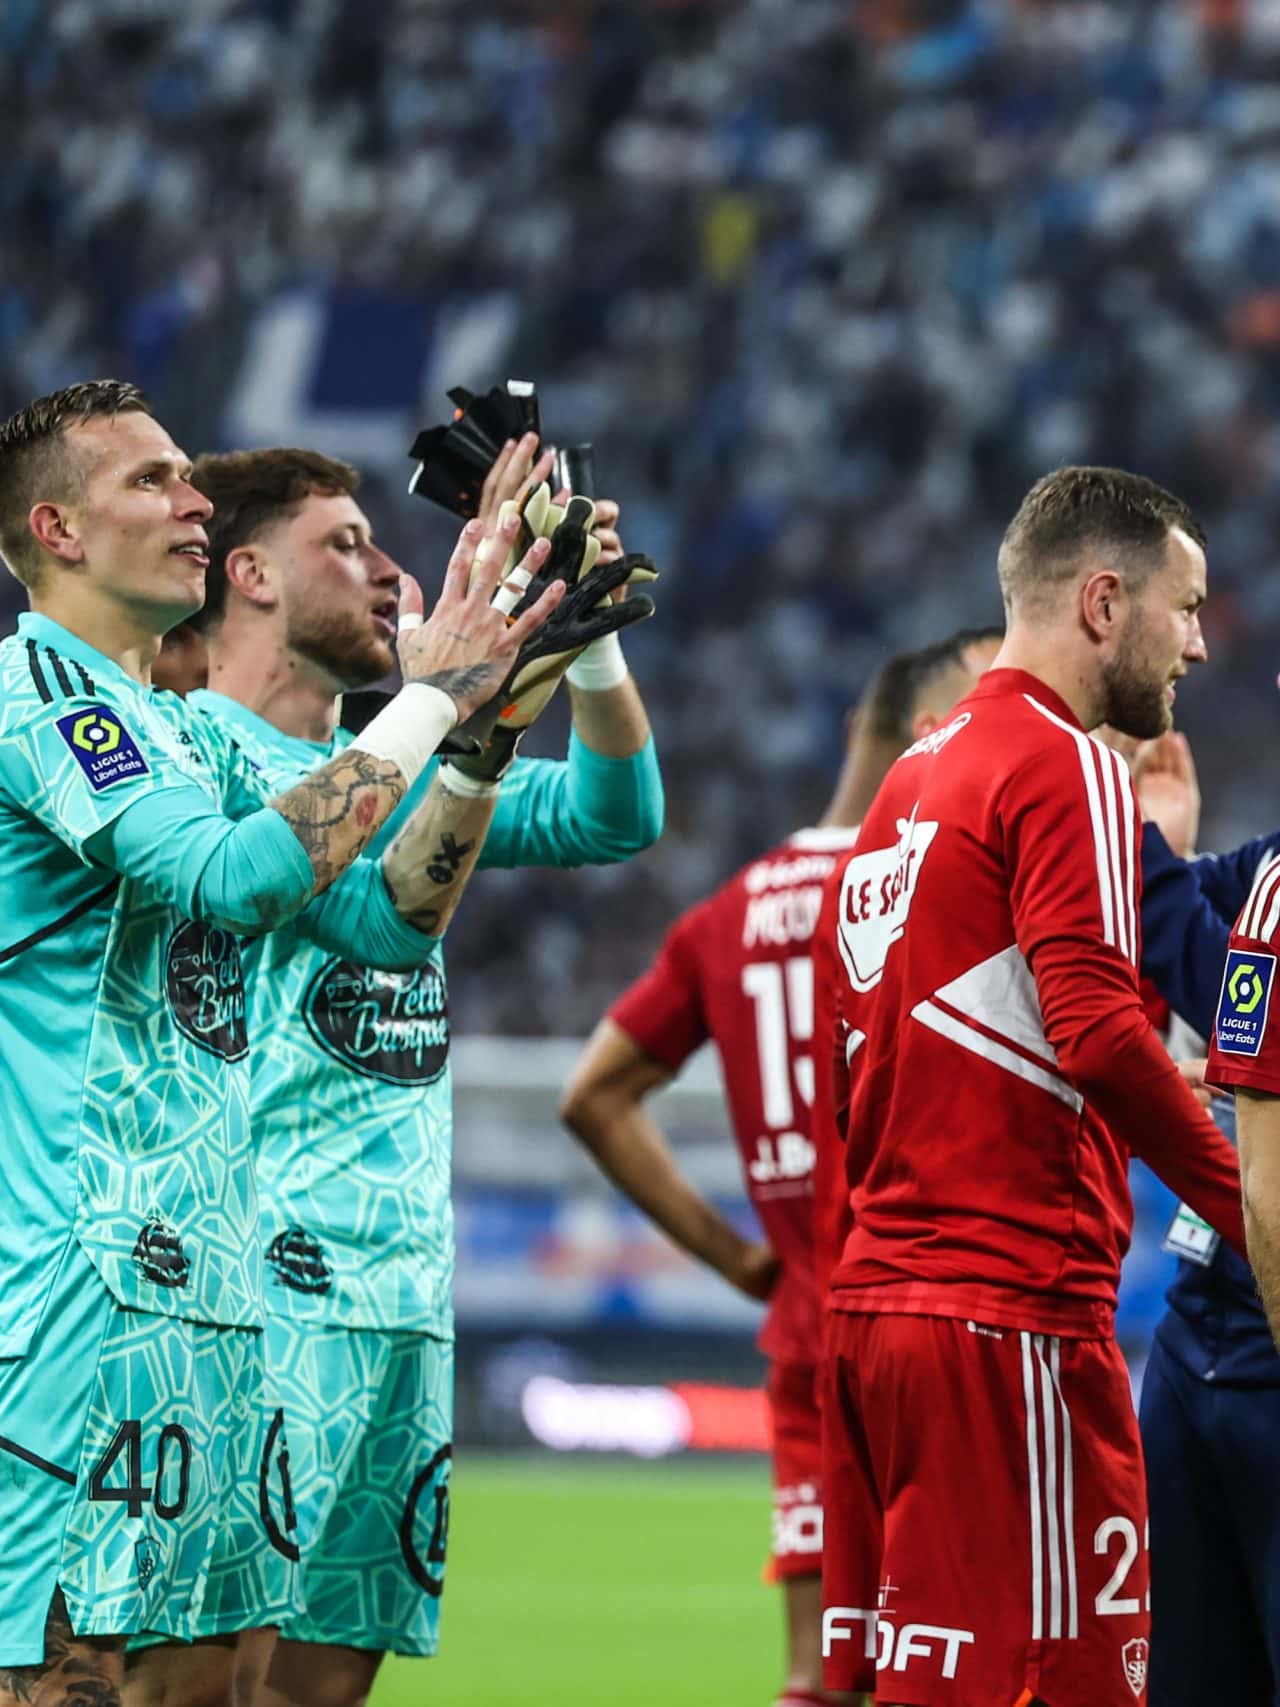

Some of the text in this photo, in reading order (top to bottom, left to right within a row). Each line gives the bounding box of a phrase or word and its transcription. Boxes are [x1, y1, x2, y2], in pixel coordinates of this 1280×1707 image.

[90, 753, 126, 772] LIGUE
[118, 760, 143, 774] Eats
[846, 878, 871, 924] LE
[1222, 1017, 1251, 1031] LIGUE
[1235, 1033, 1256, 1045] Eats
[88, 1419, 192, 1520] 40
[1094, 1515, 1151, 1615] 2
